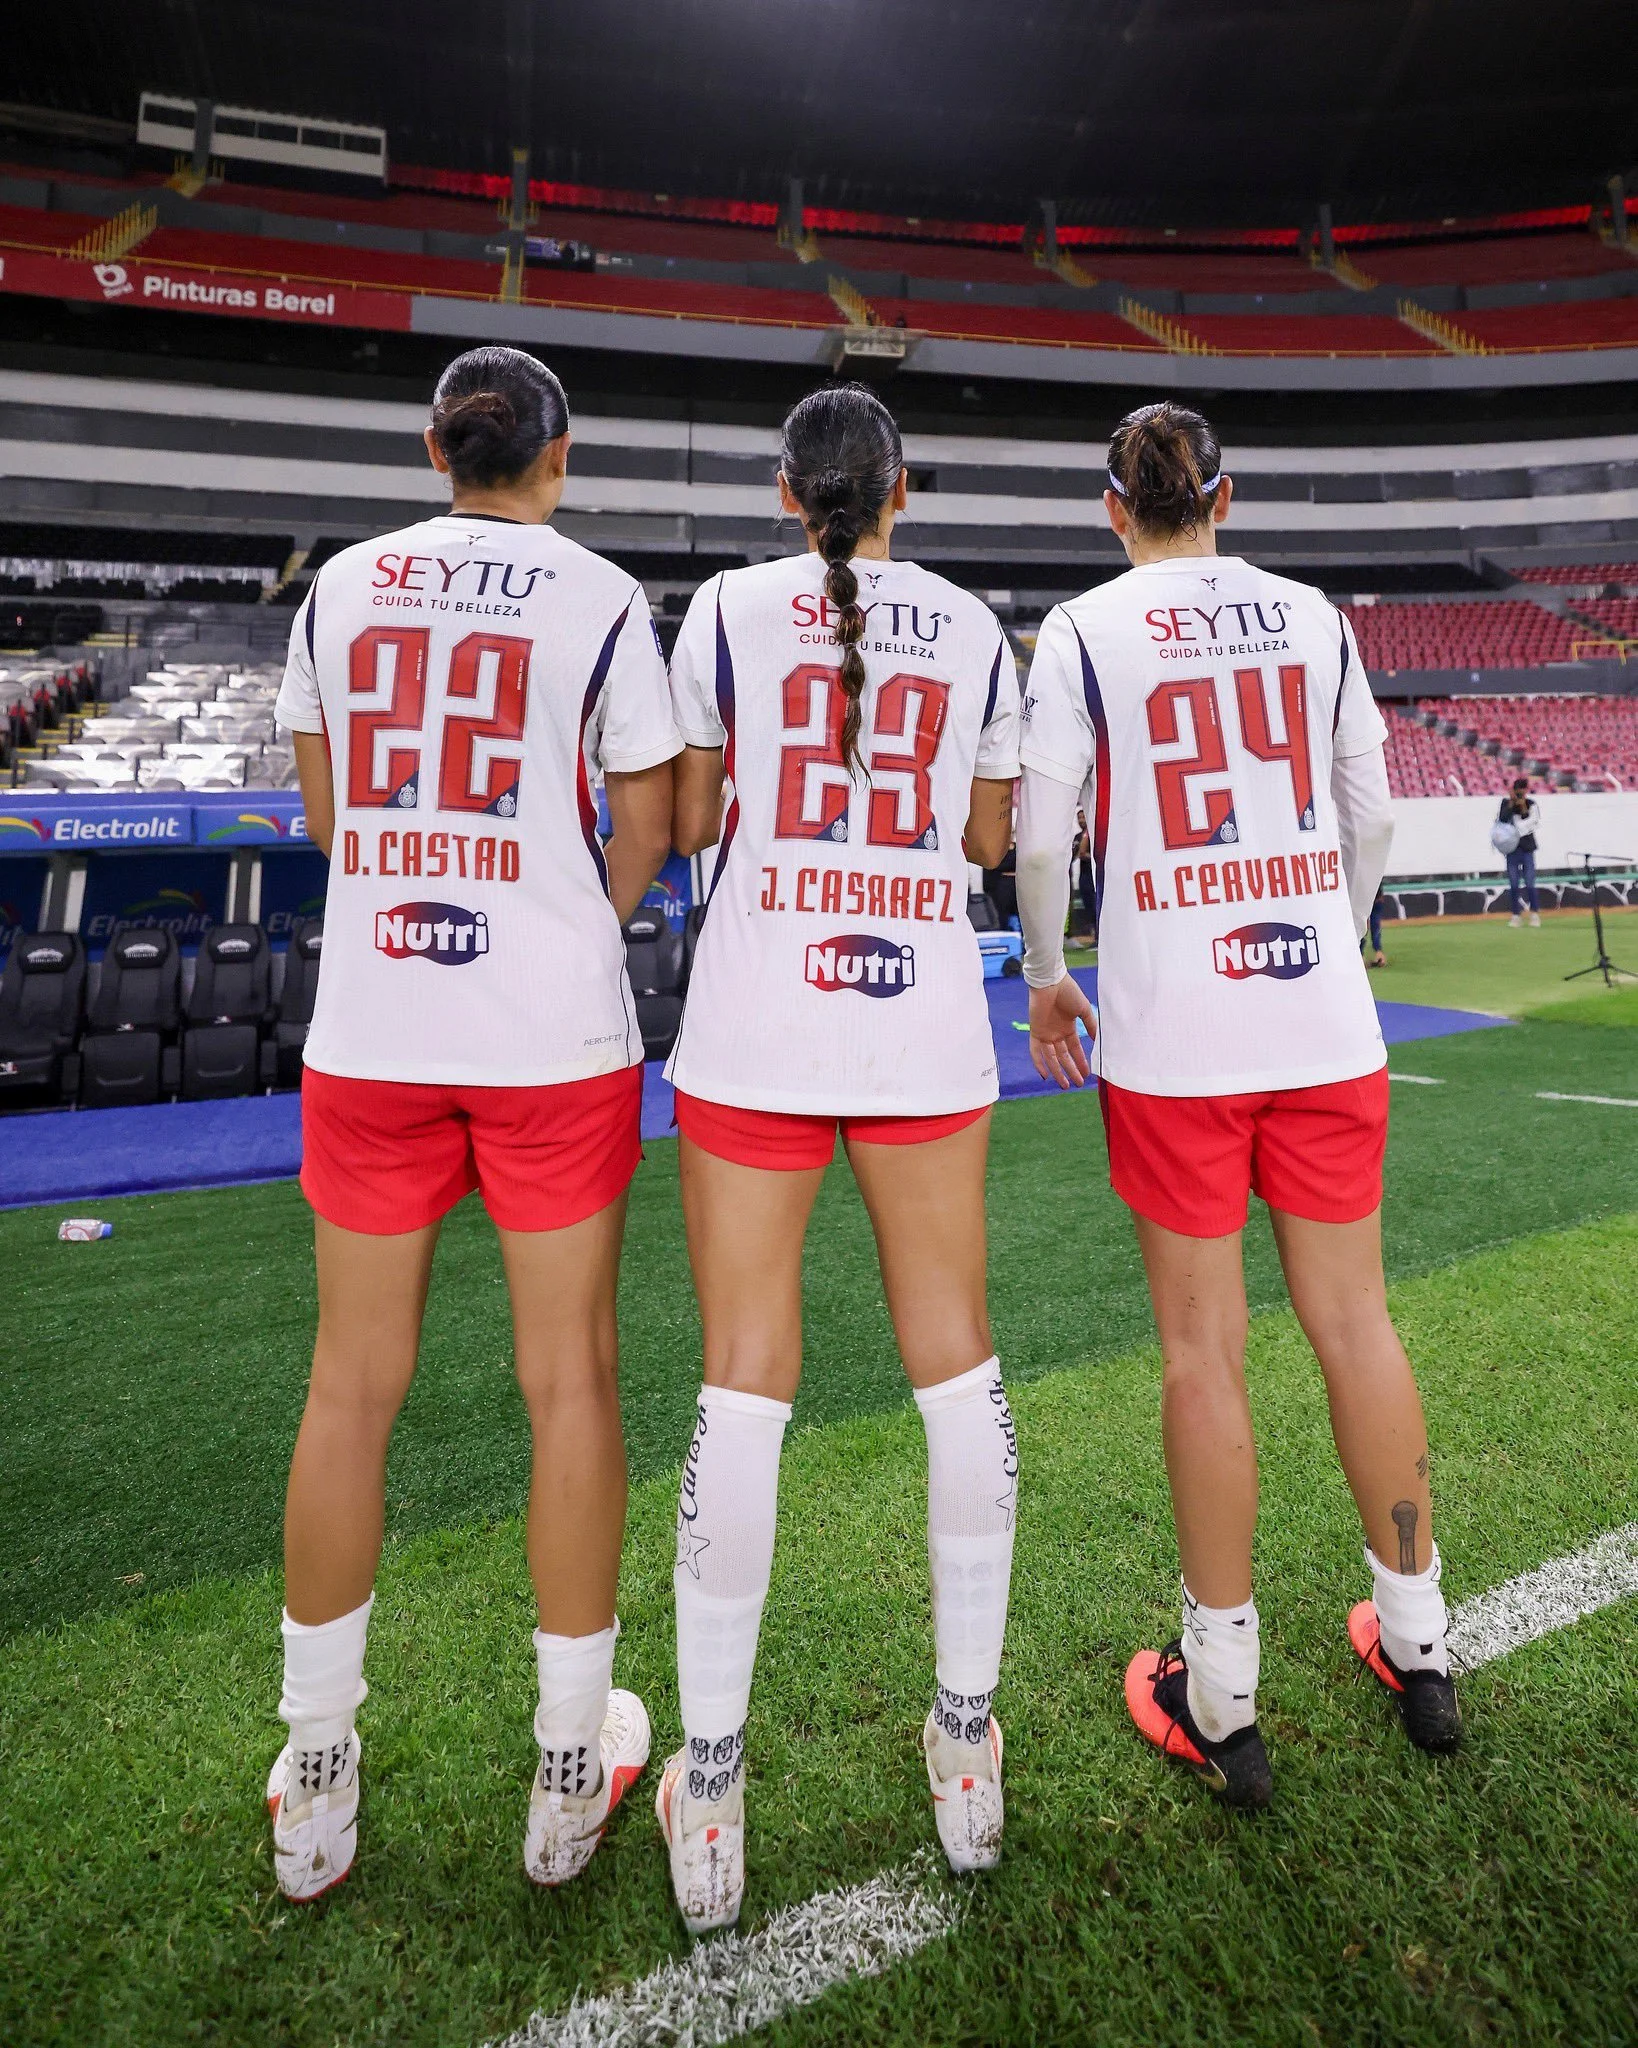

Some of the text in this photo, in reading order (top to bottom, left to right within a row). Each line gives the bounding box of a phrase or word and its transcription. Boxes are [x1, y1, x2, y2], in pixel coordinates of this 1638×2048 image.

[143, 275, 257, 308] Pinturas
[264, 287, 335, 316] Berel
[372, 595, 522, 618] CUIDA TU BELLEZA
[875, 642, 936, 661] BELLEZA
[1159, 639, 1290, 659] CUIDA TU BELLEZA
[347, 625, 534, 819] 22
[774, 662, 951, 851] 23
[1145, 664, 1317, 851] 24
[54, 816, 179, 841] Electrolit
[343, 830, 520, 883] D. CASTRO
[761, 867, 785, 912] J.
[1133, 869, 1169, 912] A.
[375, 911, 489, 954] Nutri
[1214, 926, 1319, 973] Nutri
[806, 945, 915, 986] Nutri
